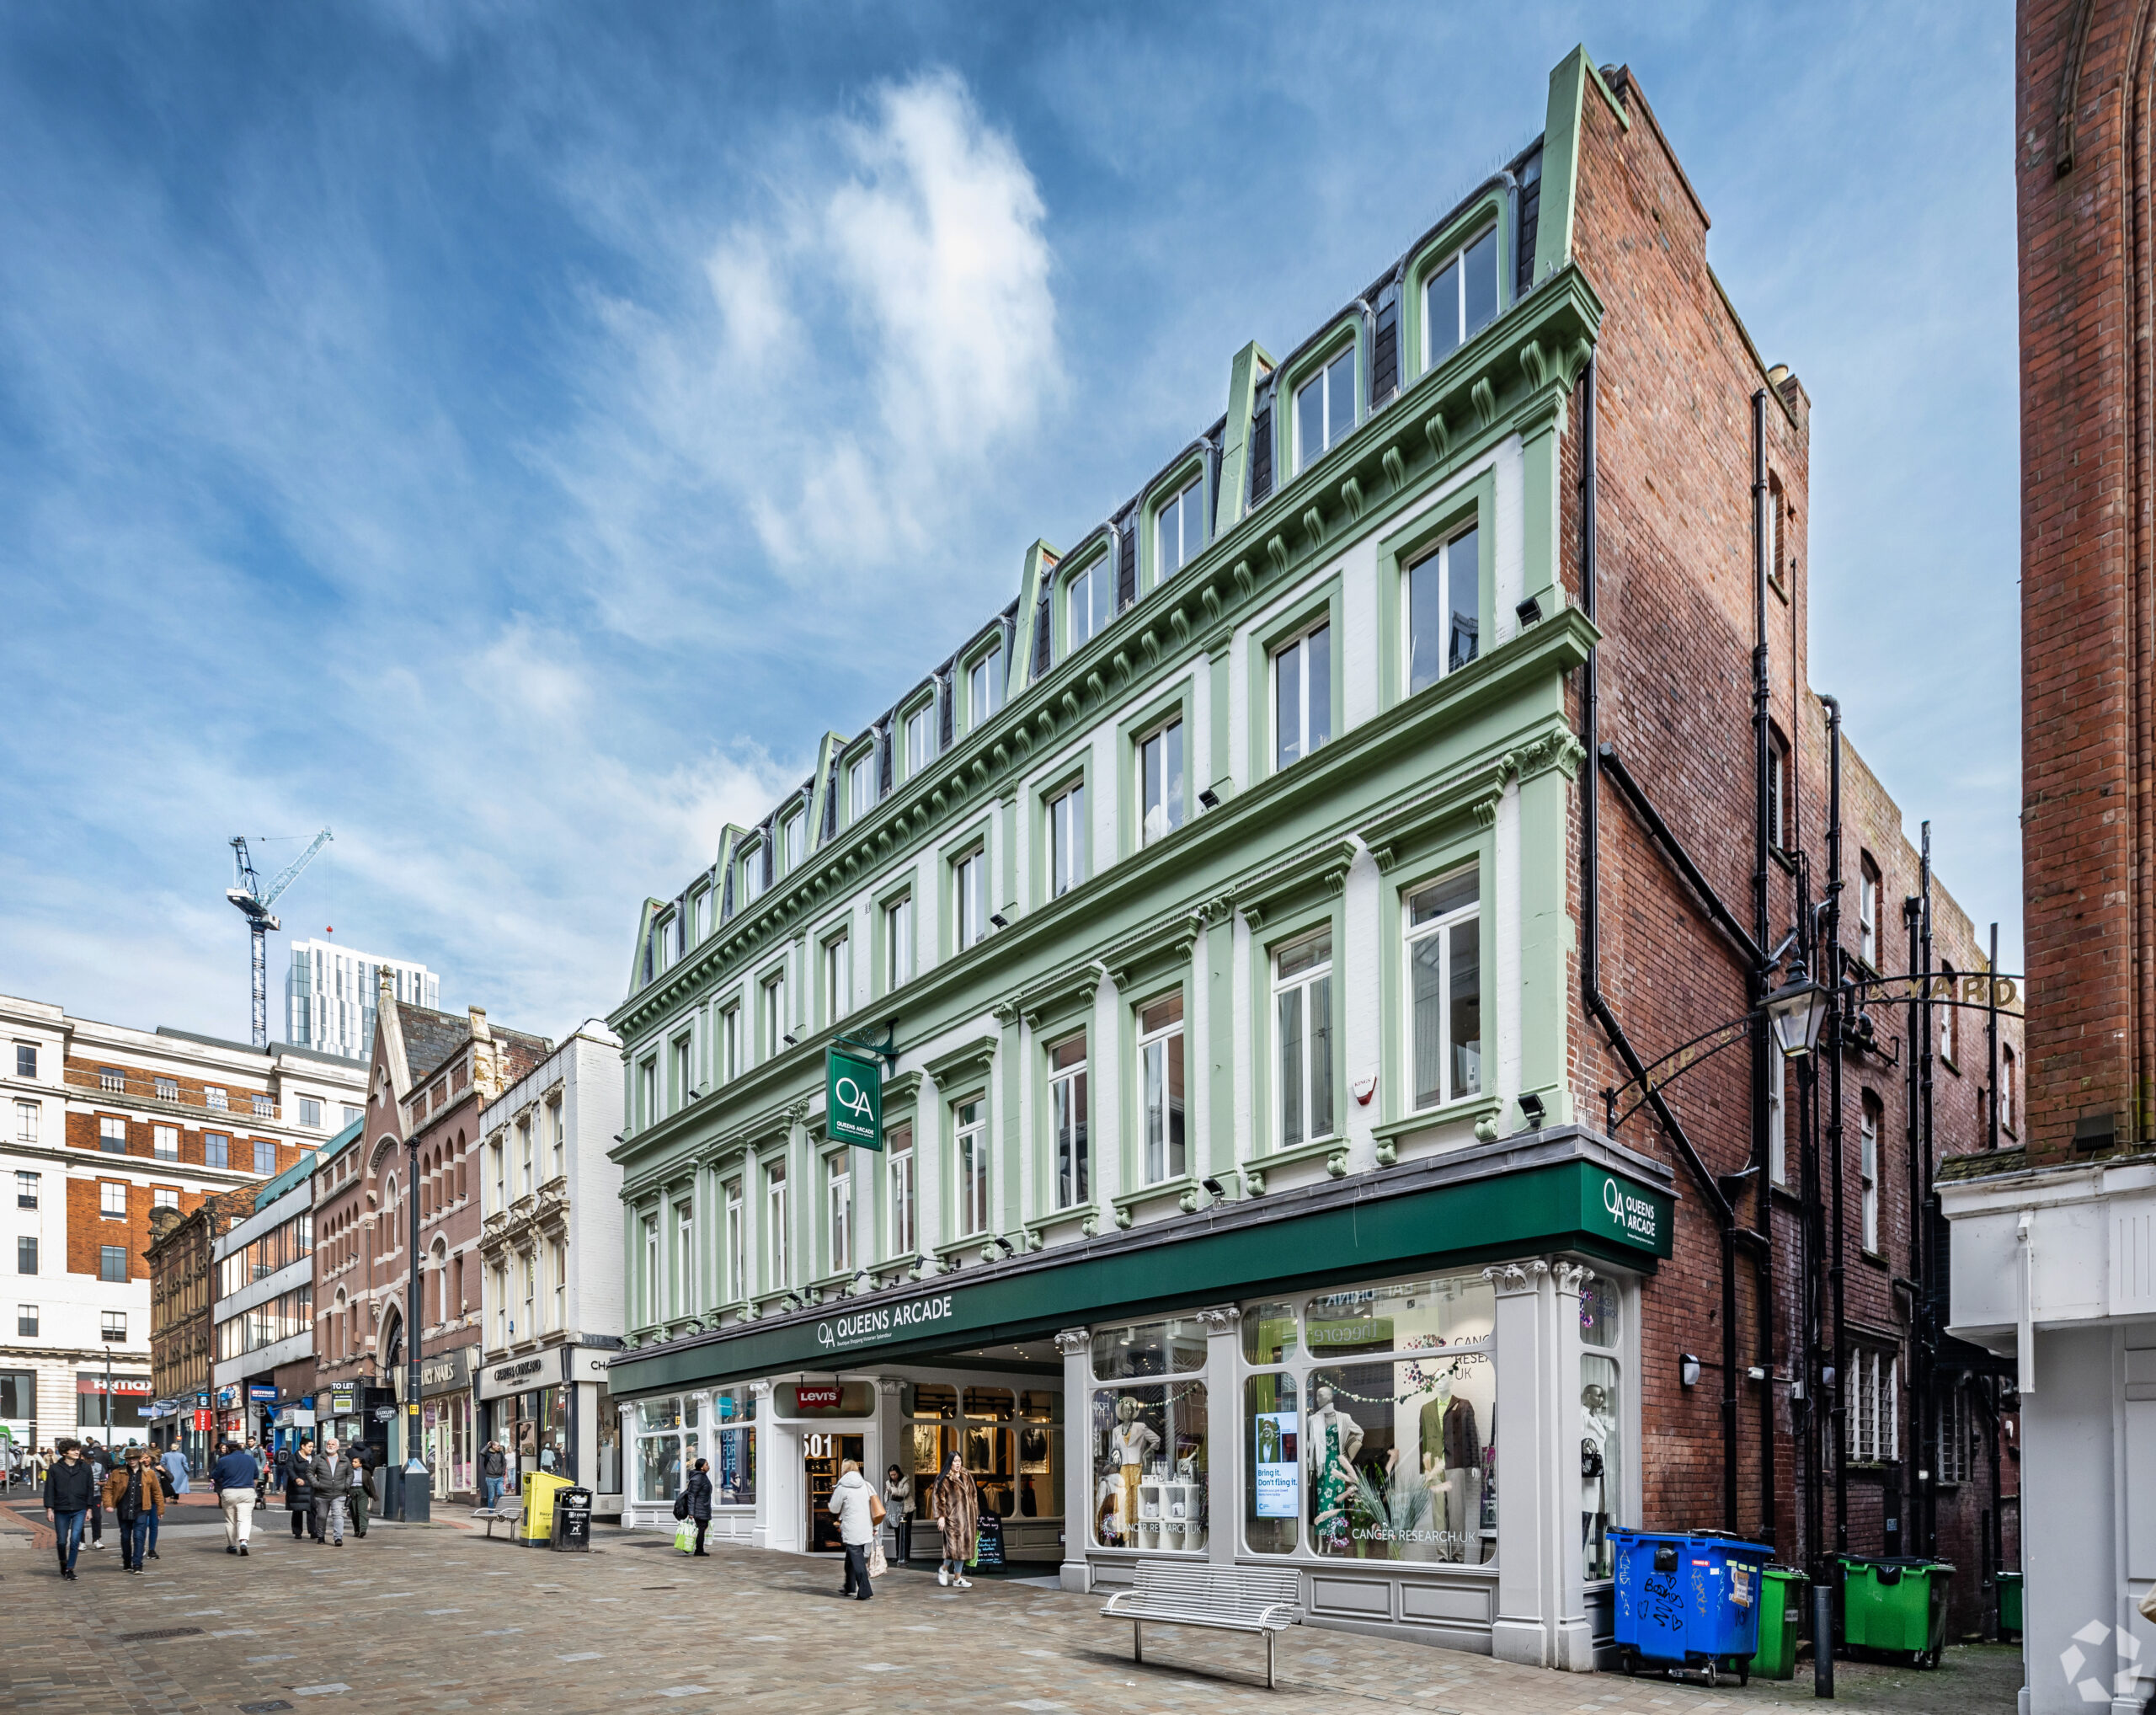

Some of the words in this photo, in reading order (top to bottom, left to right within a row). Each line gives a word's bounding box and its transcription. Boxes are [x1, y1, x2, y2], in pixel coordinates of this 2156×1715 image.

[1904, 975, 2017, 1008] YARD
[835, 1077, 874, 1121] QA
[836, 1120, 856, 1130] QUEENS
[856, 1125, 874, 1135] ARCADE
[1604, 1178, 1625, 1226] QA
[1625, 1196, 1654, 1220] QUEENS
[1627, 1214, 1656, 1237] ARCADE
[818, 1322, 835, 1349] QA
[837, 1309, 889, 1338] QUEENS
[893, 1296, 953, 1327] ARCADE
[1455, 1354, 1488, 1365] RESE
[434, 1362, 455, 1383] NAILS
[1454, 1367, 1472, 1381] UK
[723, 1429, 743, 1442] DENIM
[723, 1444, 736, 1456] FOR
[723, 1458, 736, 1471] LIFE
[1257, 1469, 1274, 1477] Bring
[1275, 1478, 1290, 1488] fling
[1190, 1524, 1202, 1534] UK
[1352, 1528, 1395, 1541] CANCER
[1398, 1530, 1456, 1542] RESEARCH
[1460, 1531, 1476, 1543] UK
